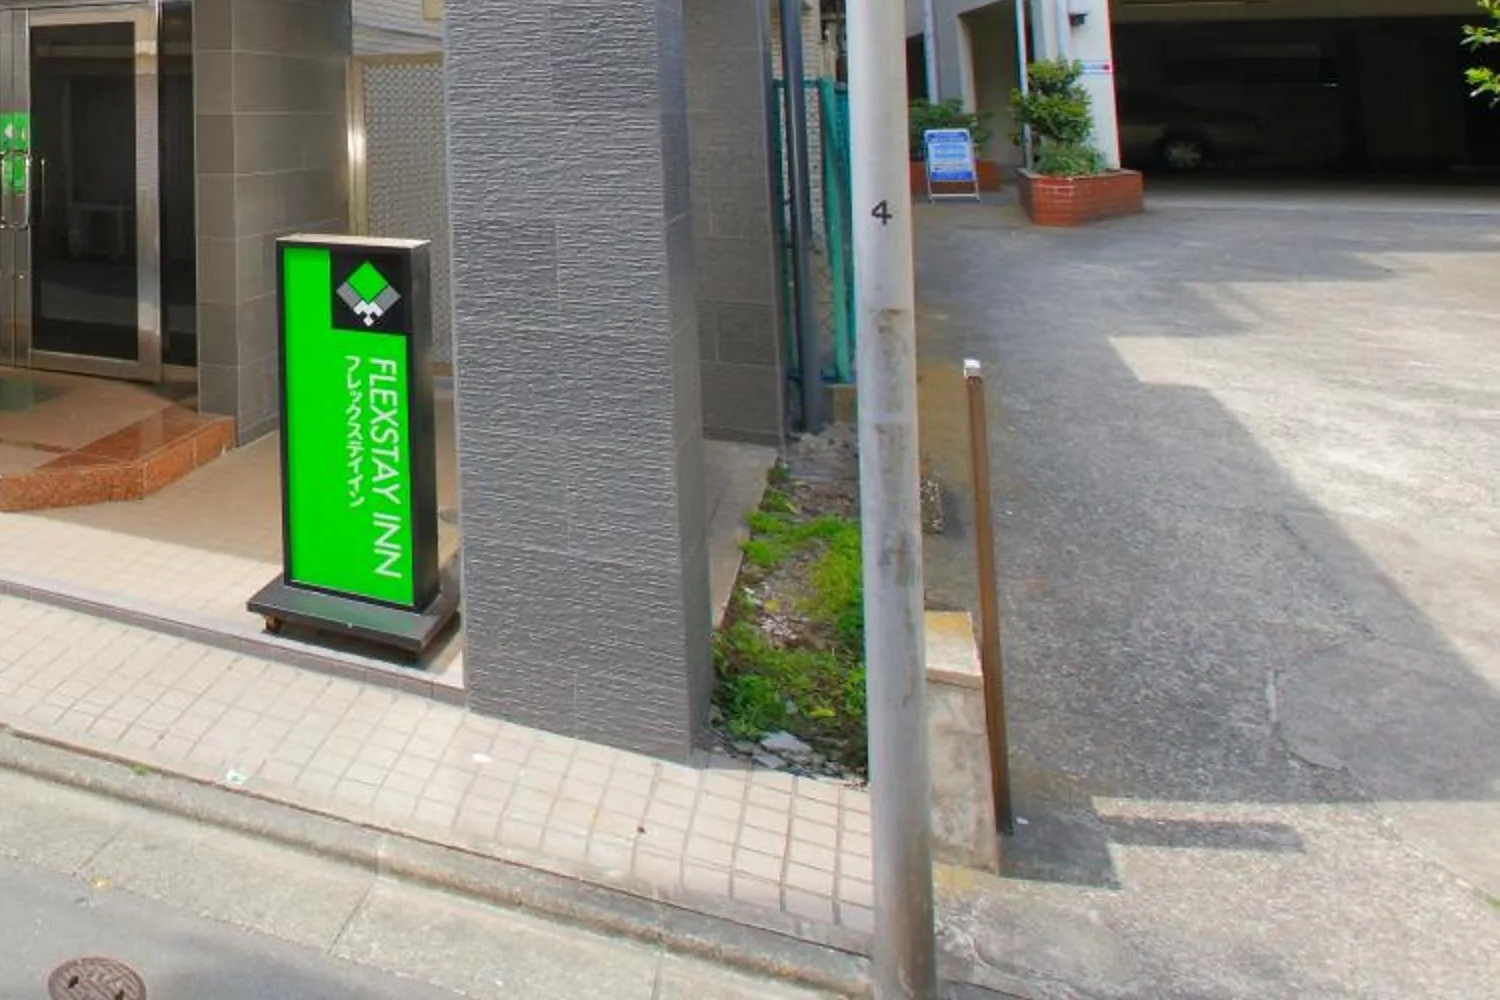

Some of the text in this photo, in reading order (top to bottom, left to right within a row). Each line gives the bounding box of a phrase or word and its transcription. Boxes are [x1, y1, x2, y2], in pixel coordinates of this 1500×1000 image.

[871, 199, 893, 226] 4
[368, 356, 403, 579] FLEXSTAY INN
